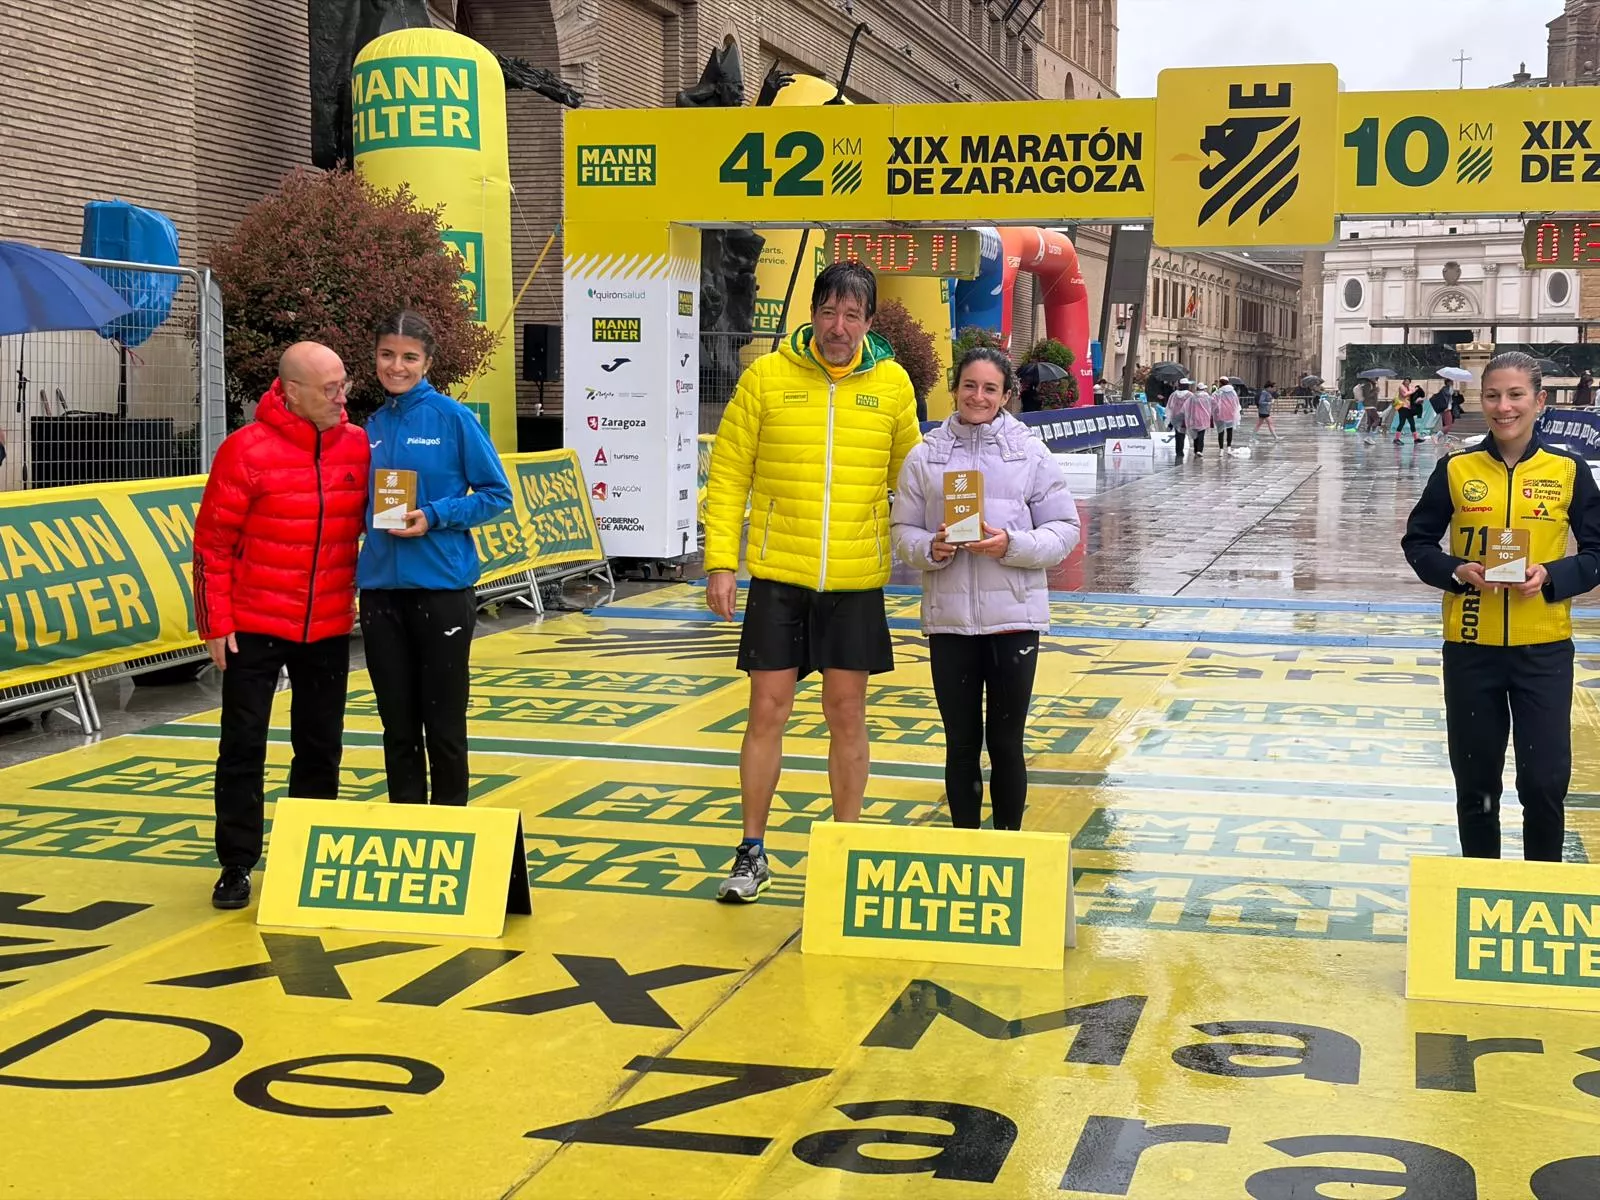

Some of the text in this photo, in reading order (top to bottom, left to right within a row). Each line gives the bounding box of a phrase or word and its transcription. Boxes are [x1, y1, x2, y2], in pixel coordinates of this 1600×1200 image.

[581, 148, 652, 165] MANN
[719, 127, 1142, 197] 42 KM XIX MARATÓN
[1344, 116, 1592, 187] 10 KM XIX
[581, 166, 652, 182] FILTER
[887, 164, 1145, 195] DE ZARAGOZA
[1521, 154, 1574, 183] DE
[595, 320, 639, 330] MANN
[595, 330, 639, 341] FILTER
[601, 418, 646, 430] Zaragoza
[601, 524, 611, 532] DE
[602, 517, 640, 525] GOBIERNO
[1460, 526, 1488, 556] 71
[0, 573, 151, 652] ILTER
[315, 833, 465, 871] MANN
[309, 868, 457, 906] FILTER
[856, 858, 1014, 898] MANN
[854, 895, 1011, 936] FILTER
[1468, 897, 1600, 938] MAN
[1467, 936, 1600, 978] FILTE
